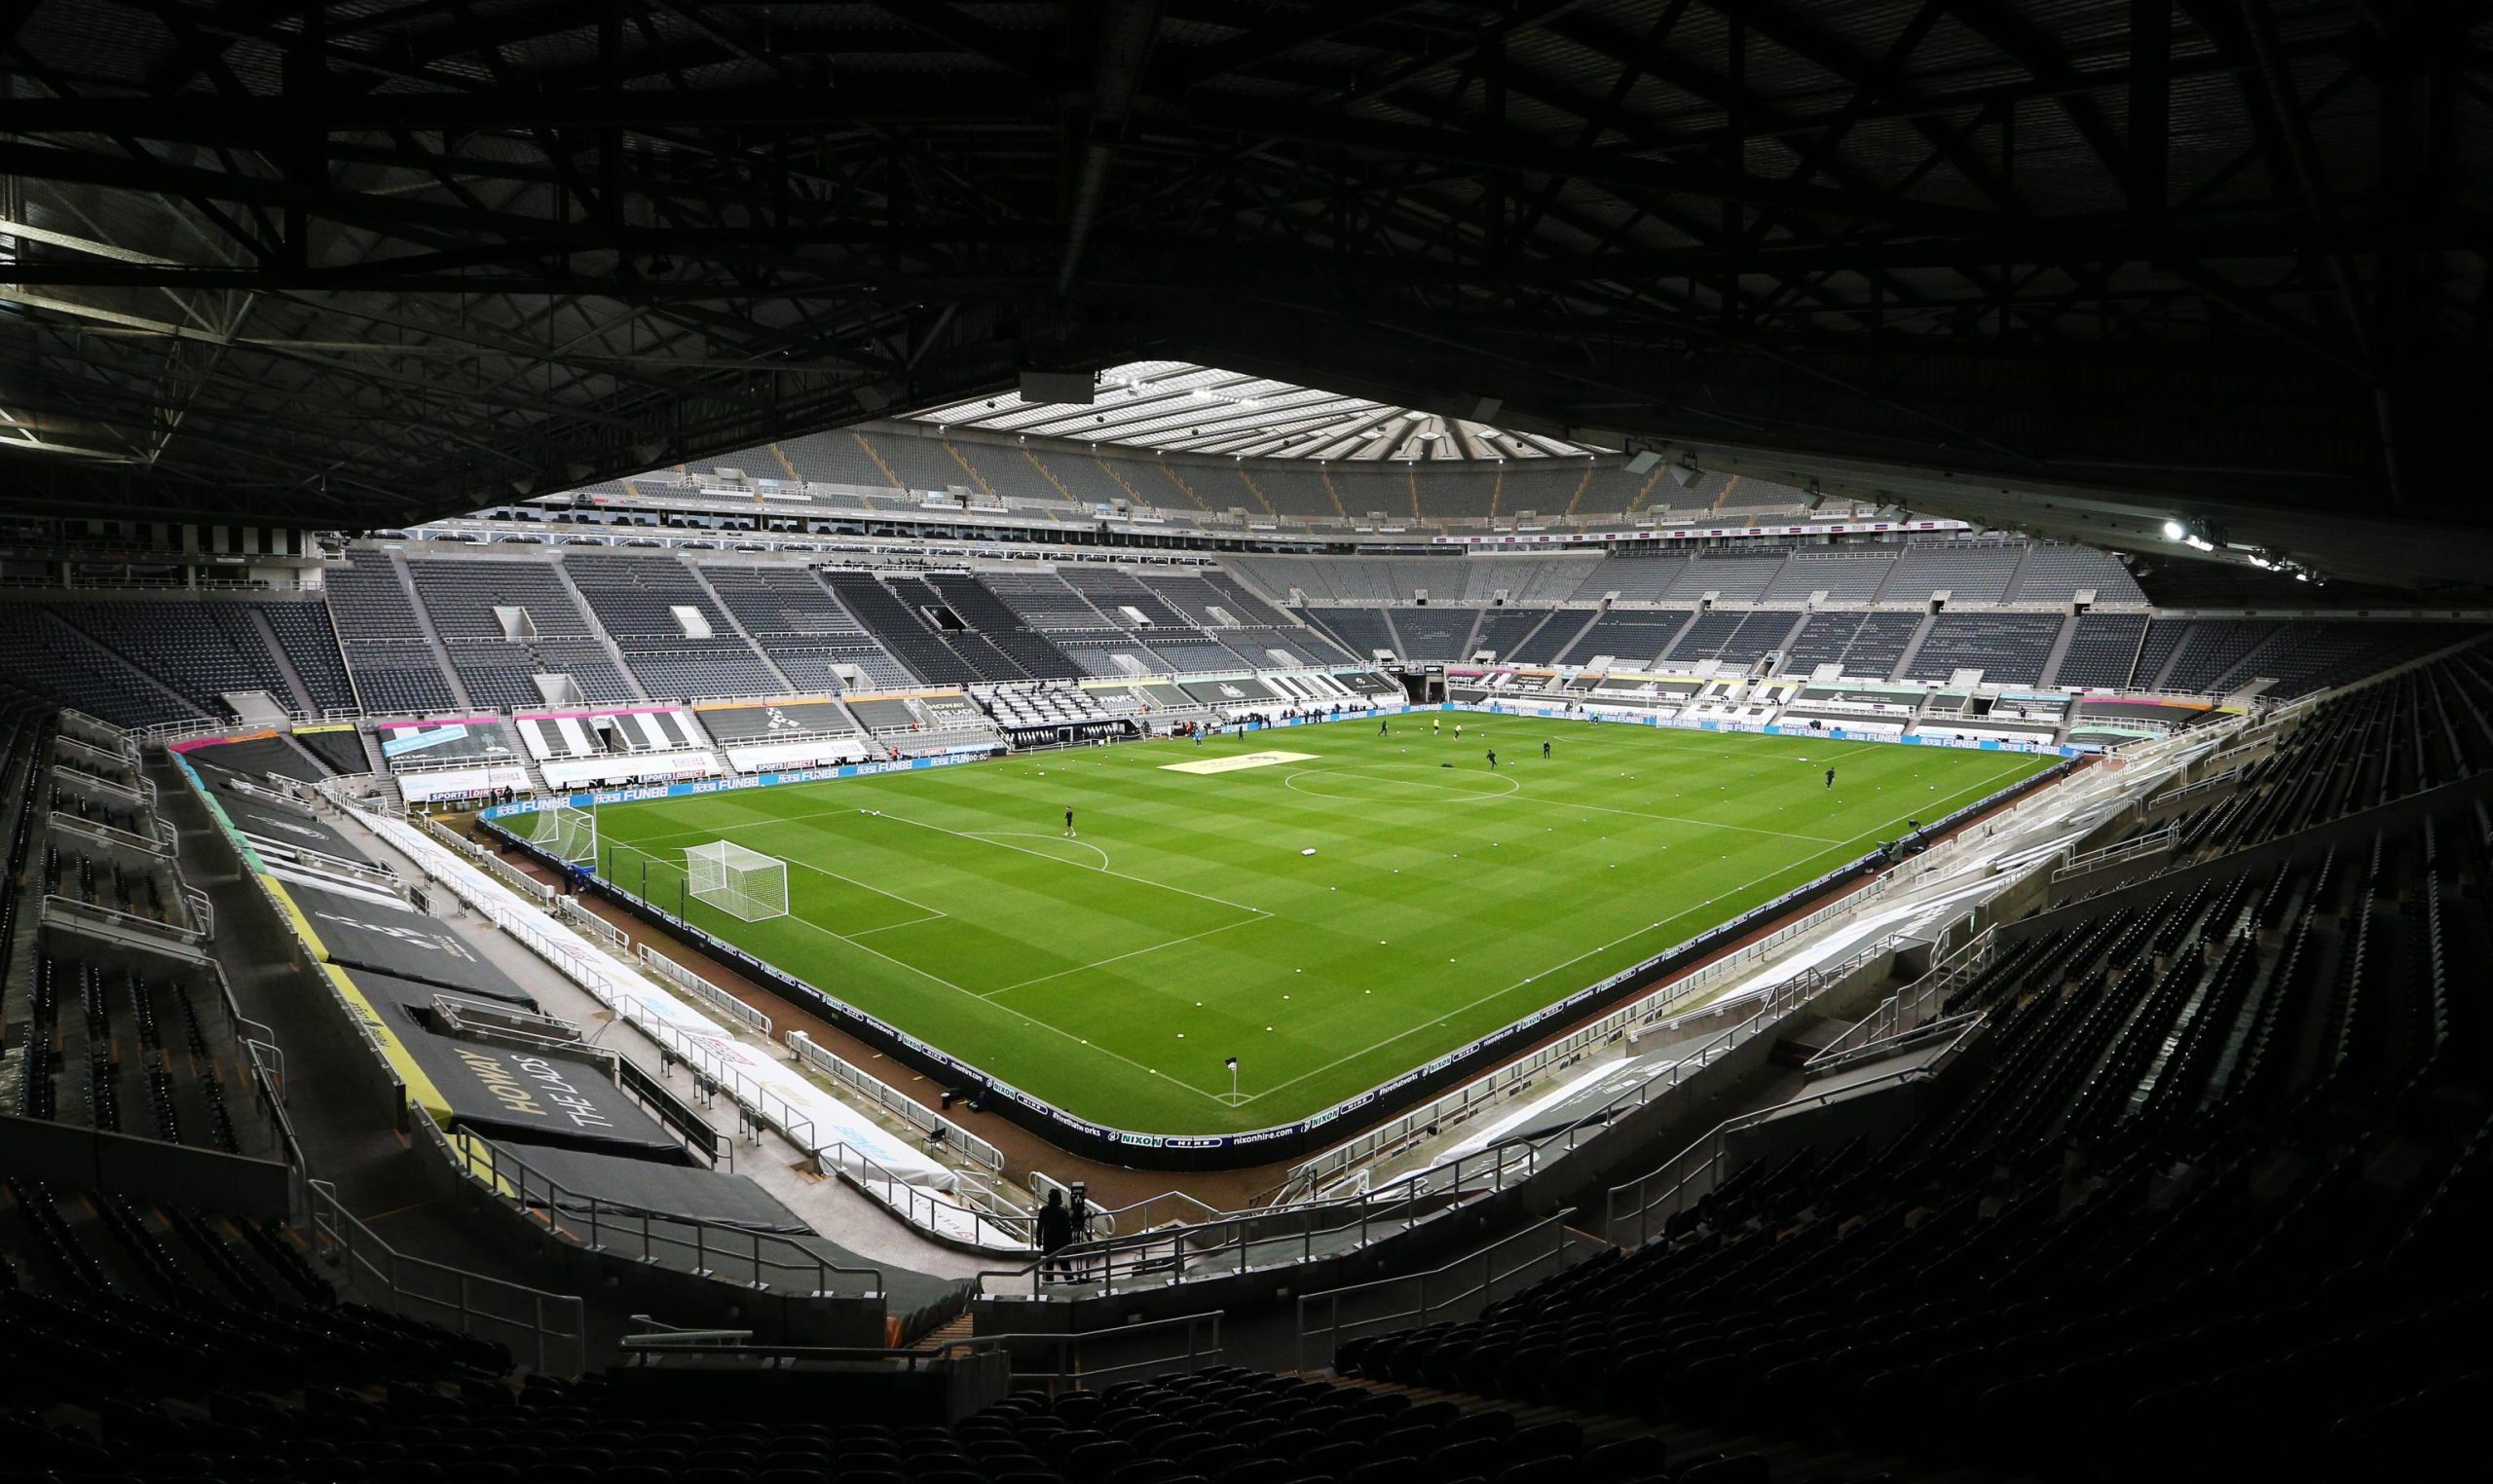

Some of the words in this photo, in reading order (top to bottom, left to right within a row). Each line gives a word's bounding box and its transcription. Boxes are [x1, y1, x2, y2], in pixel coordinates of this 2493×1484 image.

[1867, 733, 1901, 743] FUN88
[1943, 739, 1980, 749] FUN88
[2024, 744, 2060, 755] FUN88
[758, 762, 785, 771] SPORTS
[878, 760, 912, 772] FUN88
[643, 772, 673, 781] SPORTS
[676, 770, 704, 779] DIRECT
[801, 767, 839, 781] FUN88
[719, 776, 760, 791] FUN88
[431, 791, 468, 800] SPORTS
[472, 788, 506, 797] DIRCT
[623, 787, 668, 800] FUN88
[1522, 1016, 1541, 1028] NIXON
[904, 1038, 921, 1052] NIXON
[1430, 1057, 1451, 1072] NIXON
[511, 1055, 578, 1094] LADS
[454, 1048, 548, 1116] HOWAY
[1379, 1072, 1419, 1096] #hirethatworks
[994, 1083, 1015, 1099] NIXON
[548, 1093, 614, 1128] THE
[1312, 1110, 1339, 1127] NIXON
[1123, 1134, 1162, 1147] NIXON
[1234, 1128, 1293, 1146] nixonhire.com
